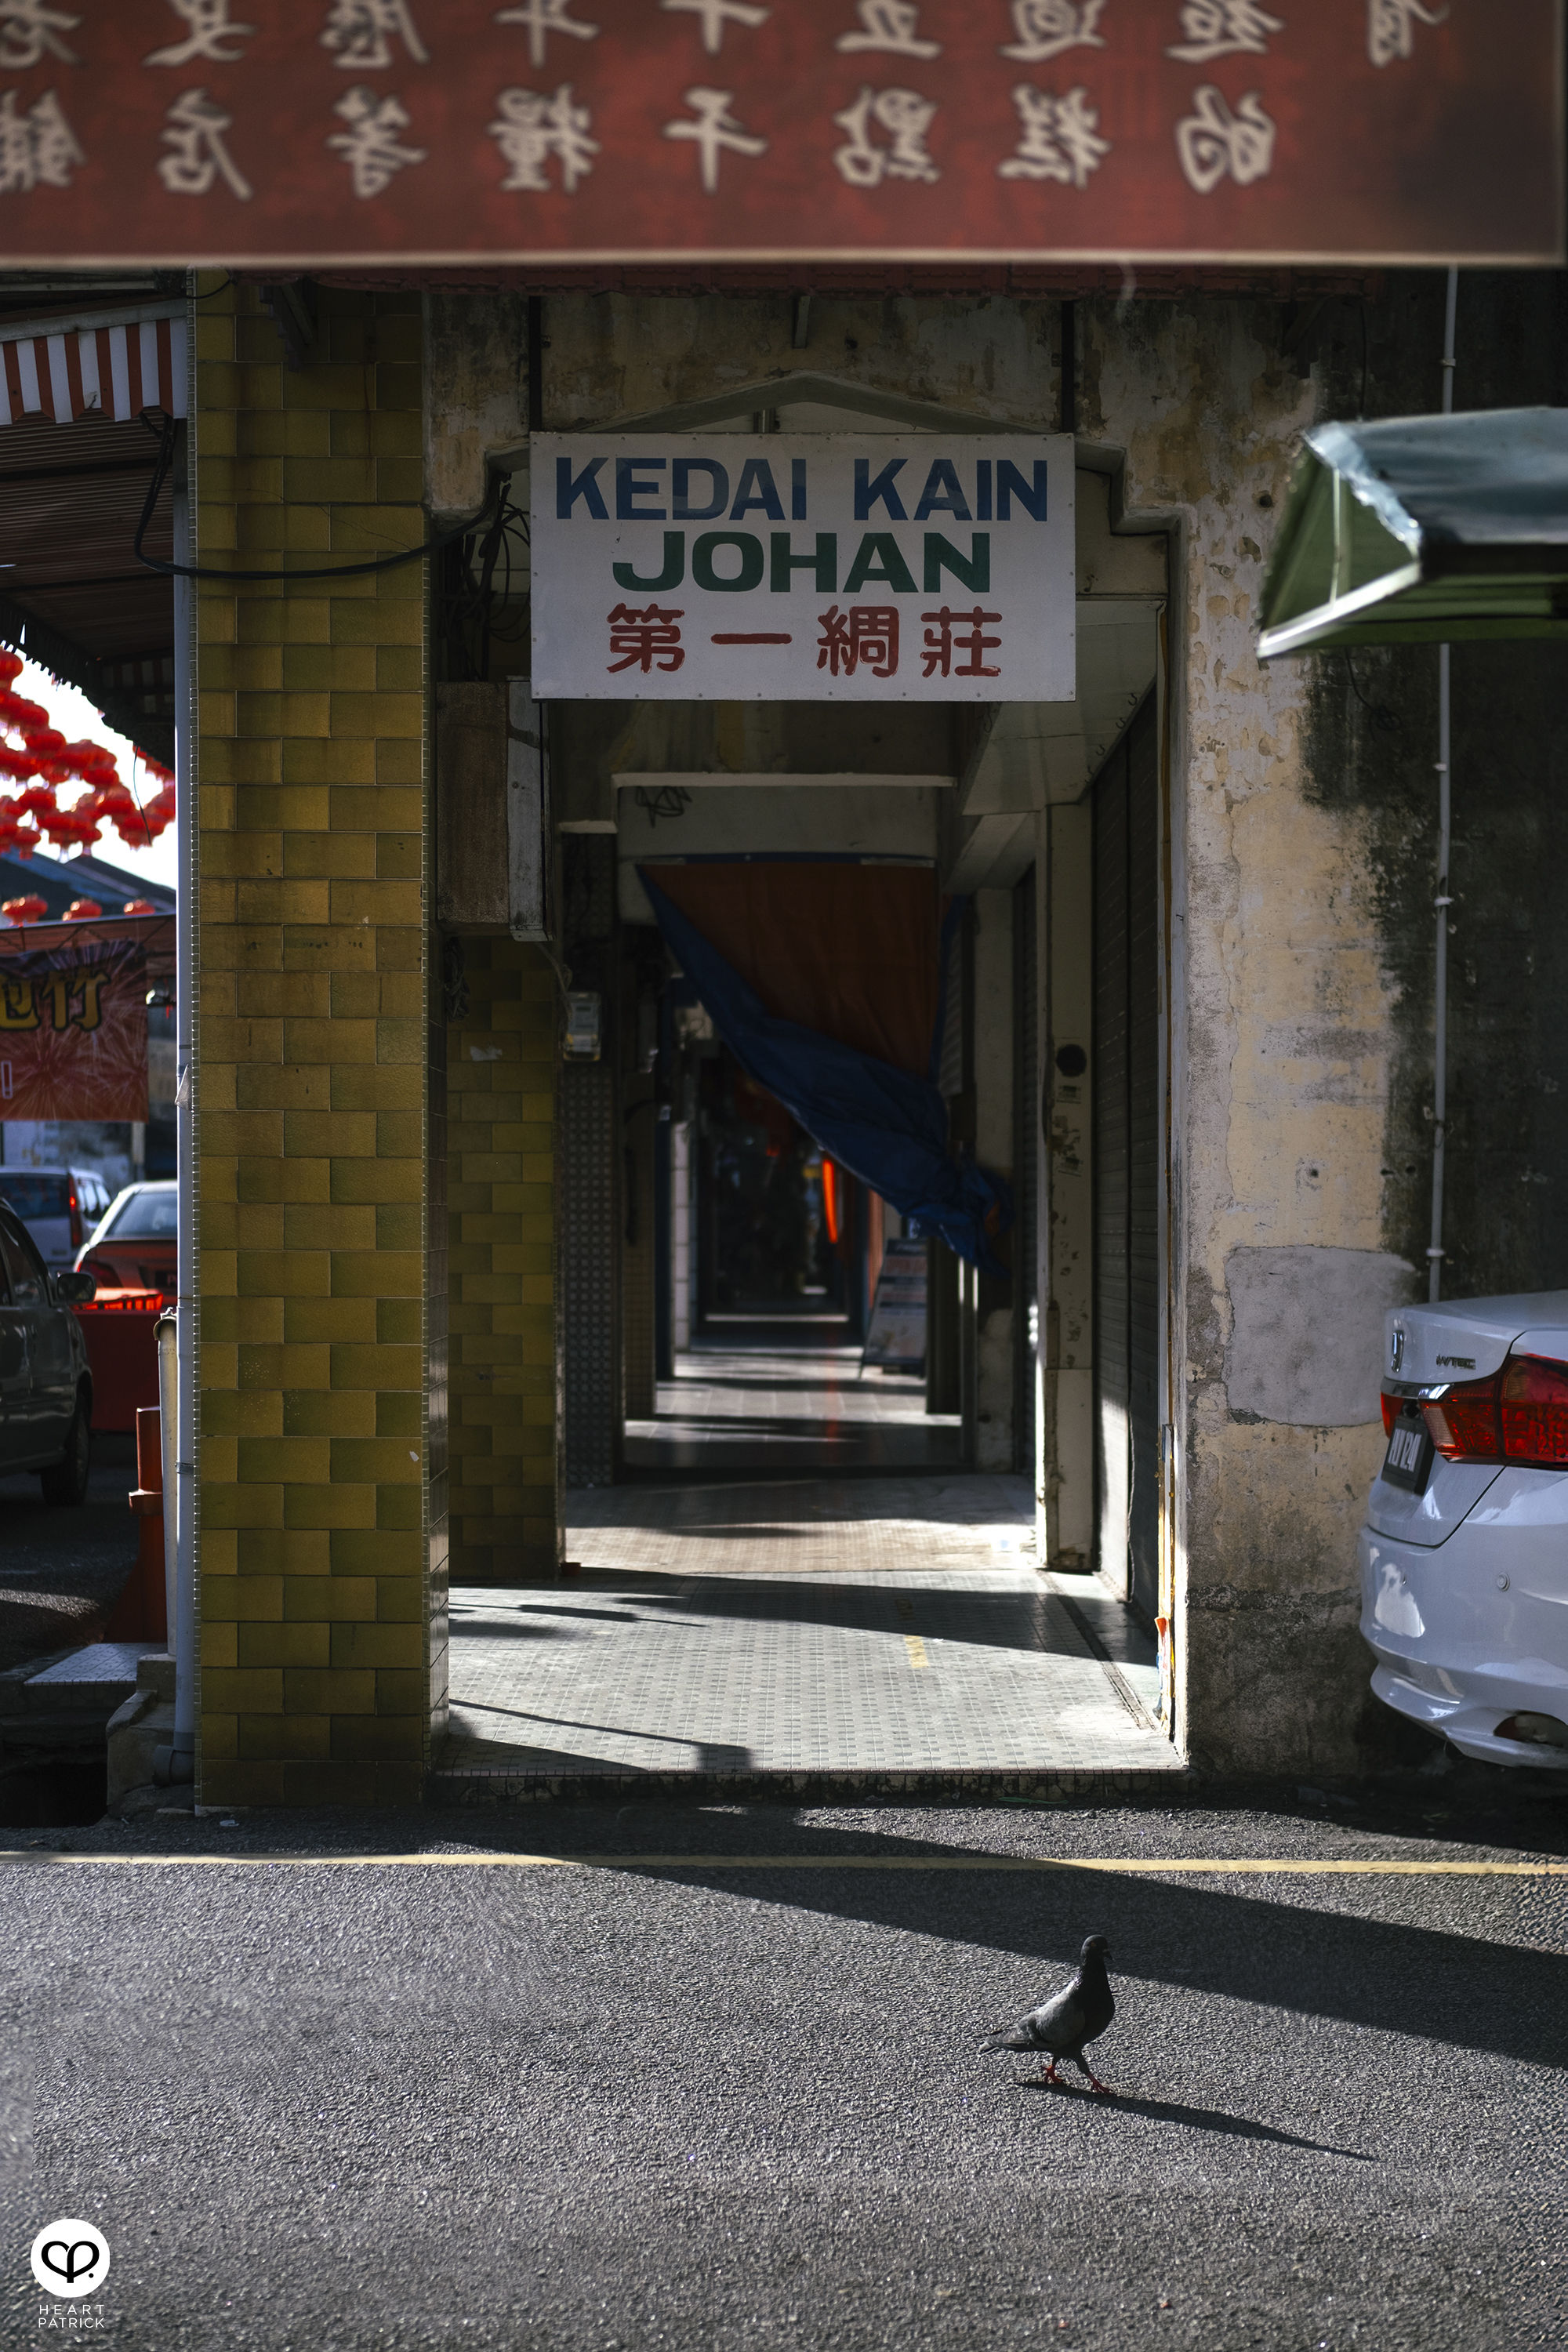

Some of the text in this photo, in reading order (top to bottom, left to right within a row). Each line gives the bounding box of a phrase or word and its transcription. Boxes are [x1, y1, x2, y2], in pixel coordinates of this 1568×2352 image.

[556, 456, 1048, 522] KEDAI KAIN
[612, 530, 991, 593] JOHAN
[605, 602, 1004, 678] 第一綢莊
